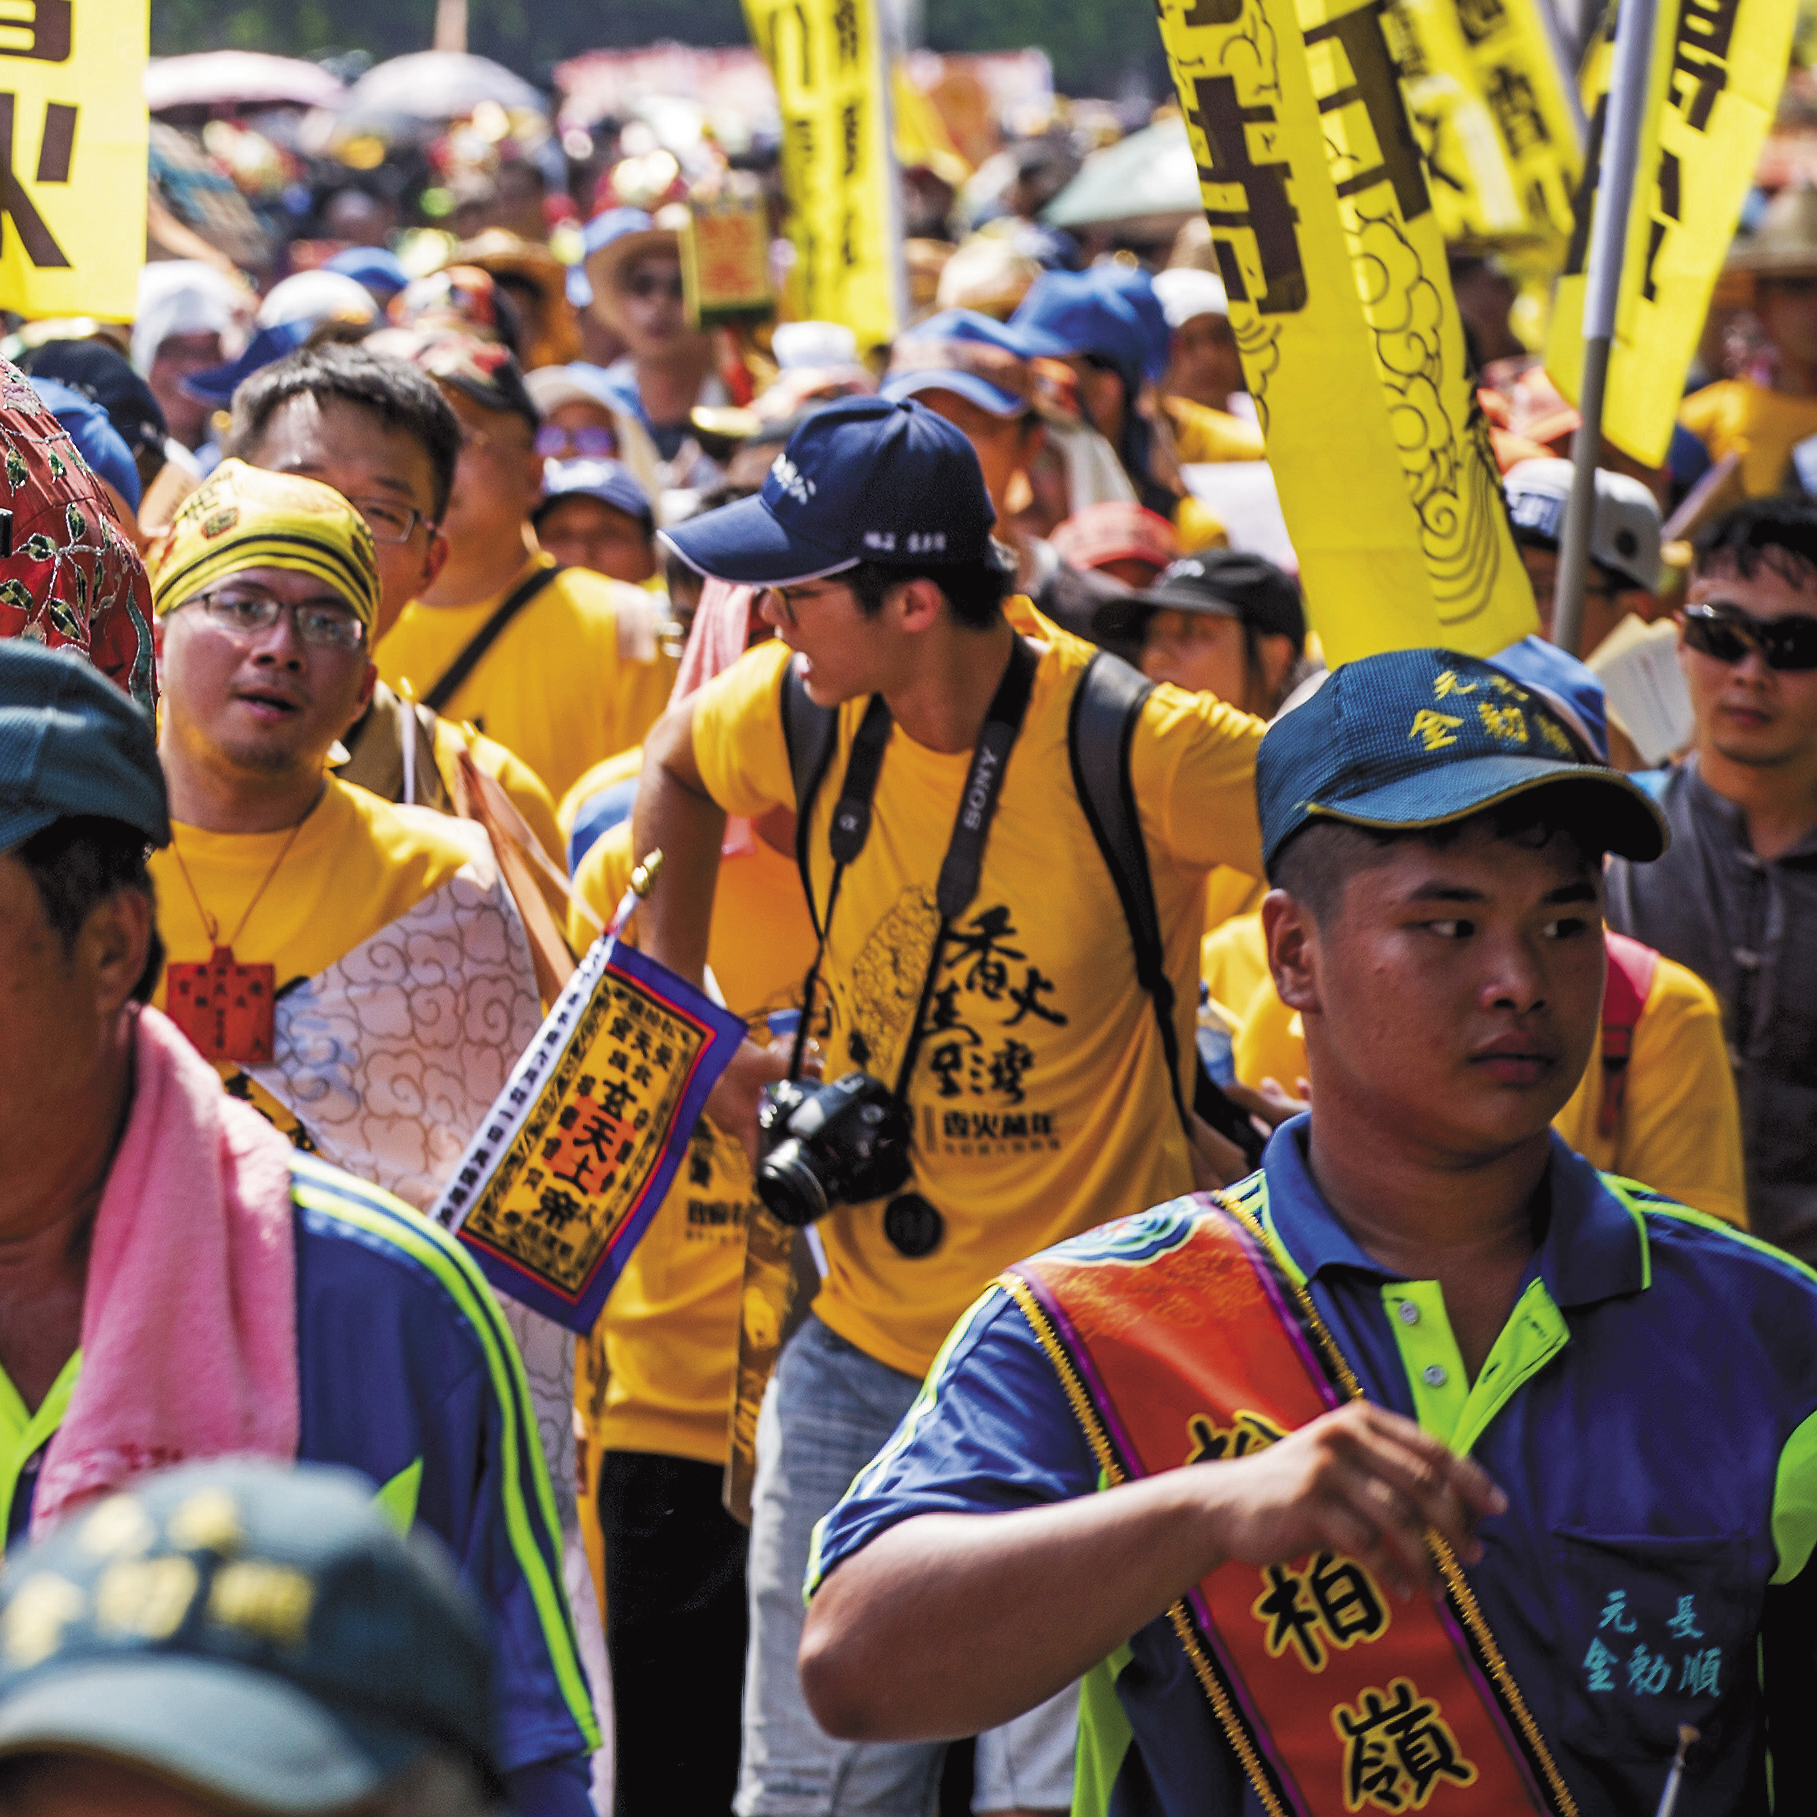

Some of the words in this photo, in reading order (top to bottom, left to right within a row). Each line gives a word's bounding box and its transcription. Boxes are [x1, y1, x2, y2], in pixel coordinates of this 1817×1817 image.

[963, 745, 998, 831] SONY
[531, 1078, 639, 1230] 玄天上帝
